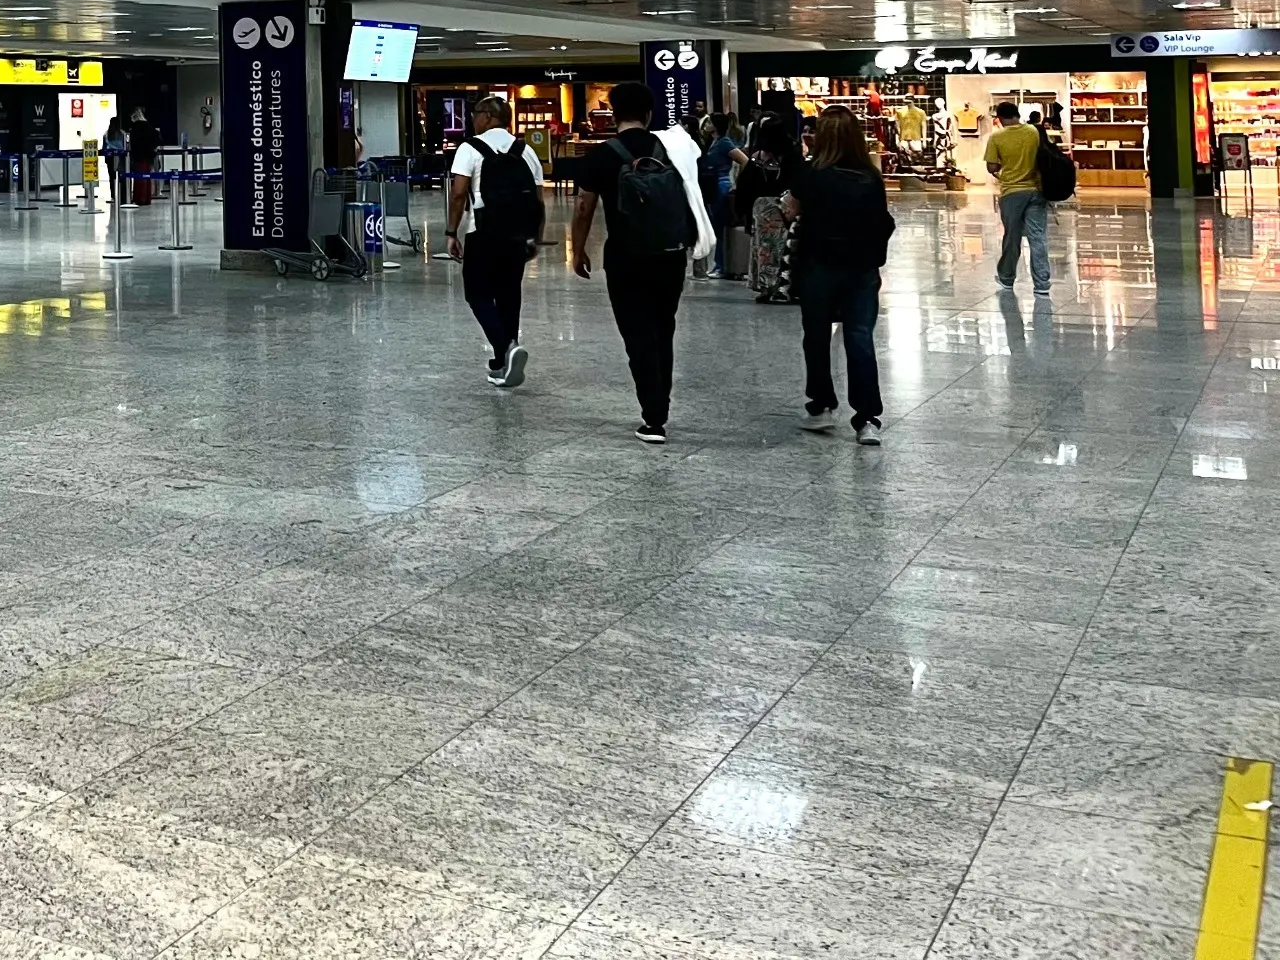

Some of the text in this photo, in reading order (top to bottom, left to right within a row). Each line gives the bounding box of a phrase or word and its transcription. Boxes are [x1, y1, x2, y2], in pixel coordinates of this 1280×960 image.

[1164, 34, 1184, 42] Sala
[1164, 45, 1214, 53] VIP Lounge
[680, 83, 689, 117] rtures
[249, 60, 266, 237] Embarque doméstico
[269, 69, 285, 238] Domestic departures
